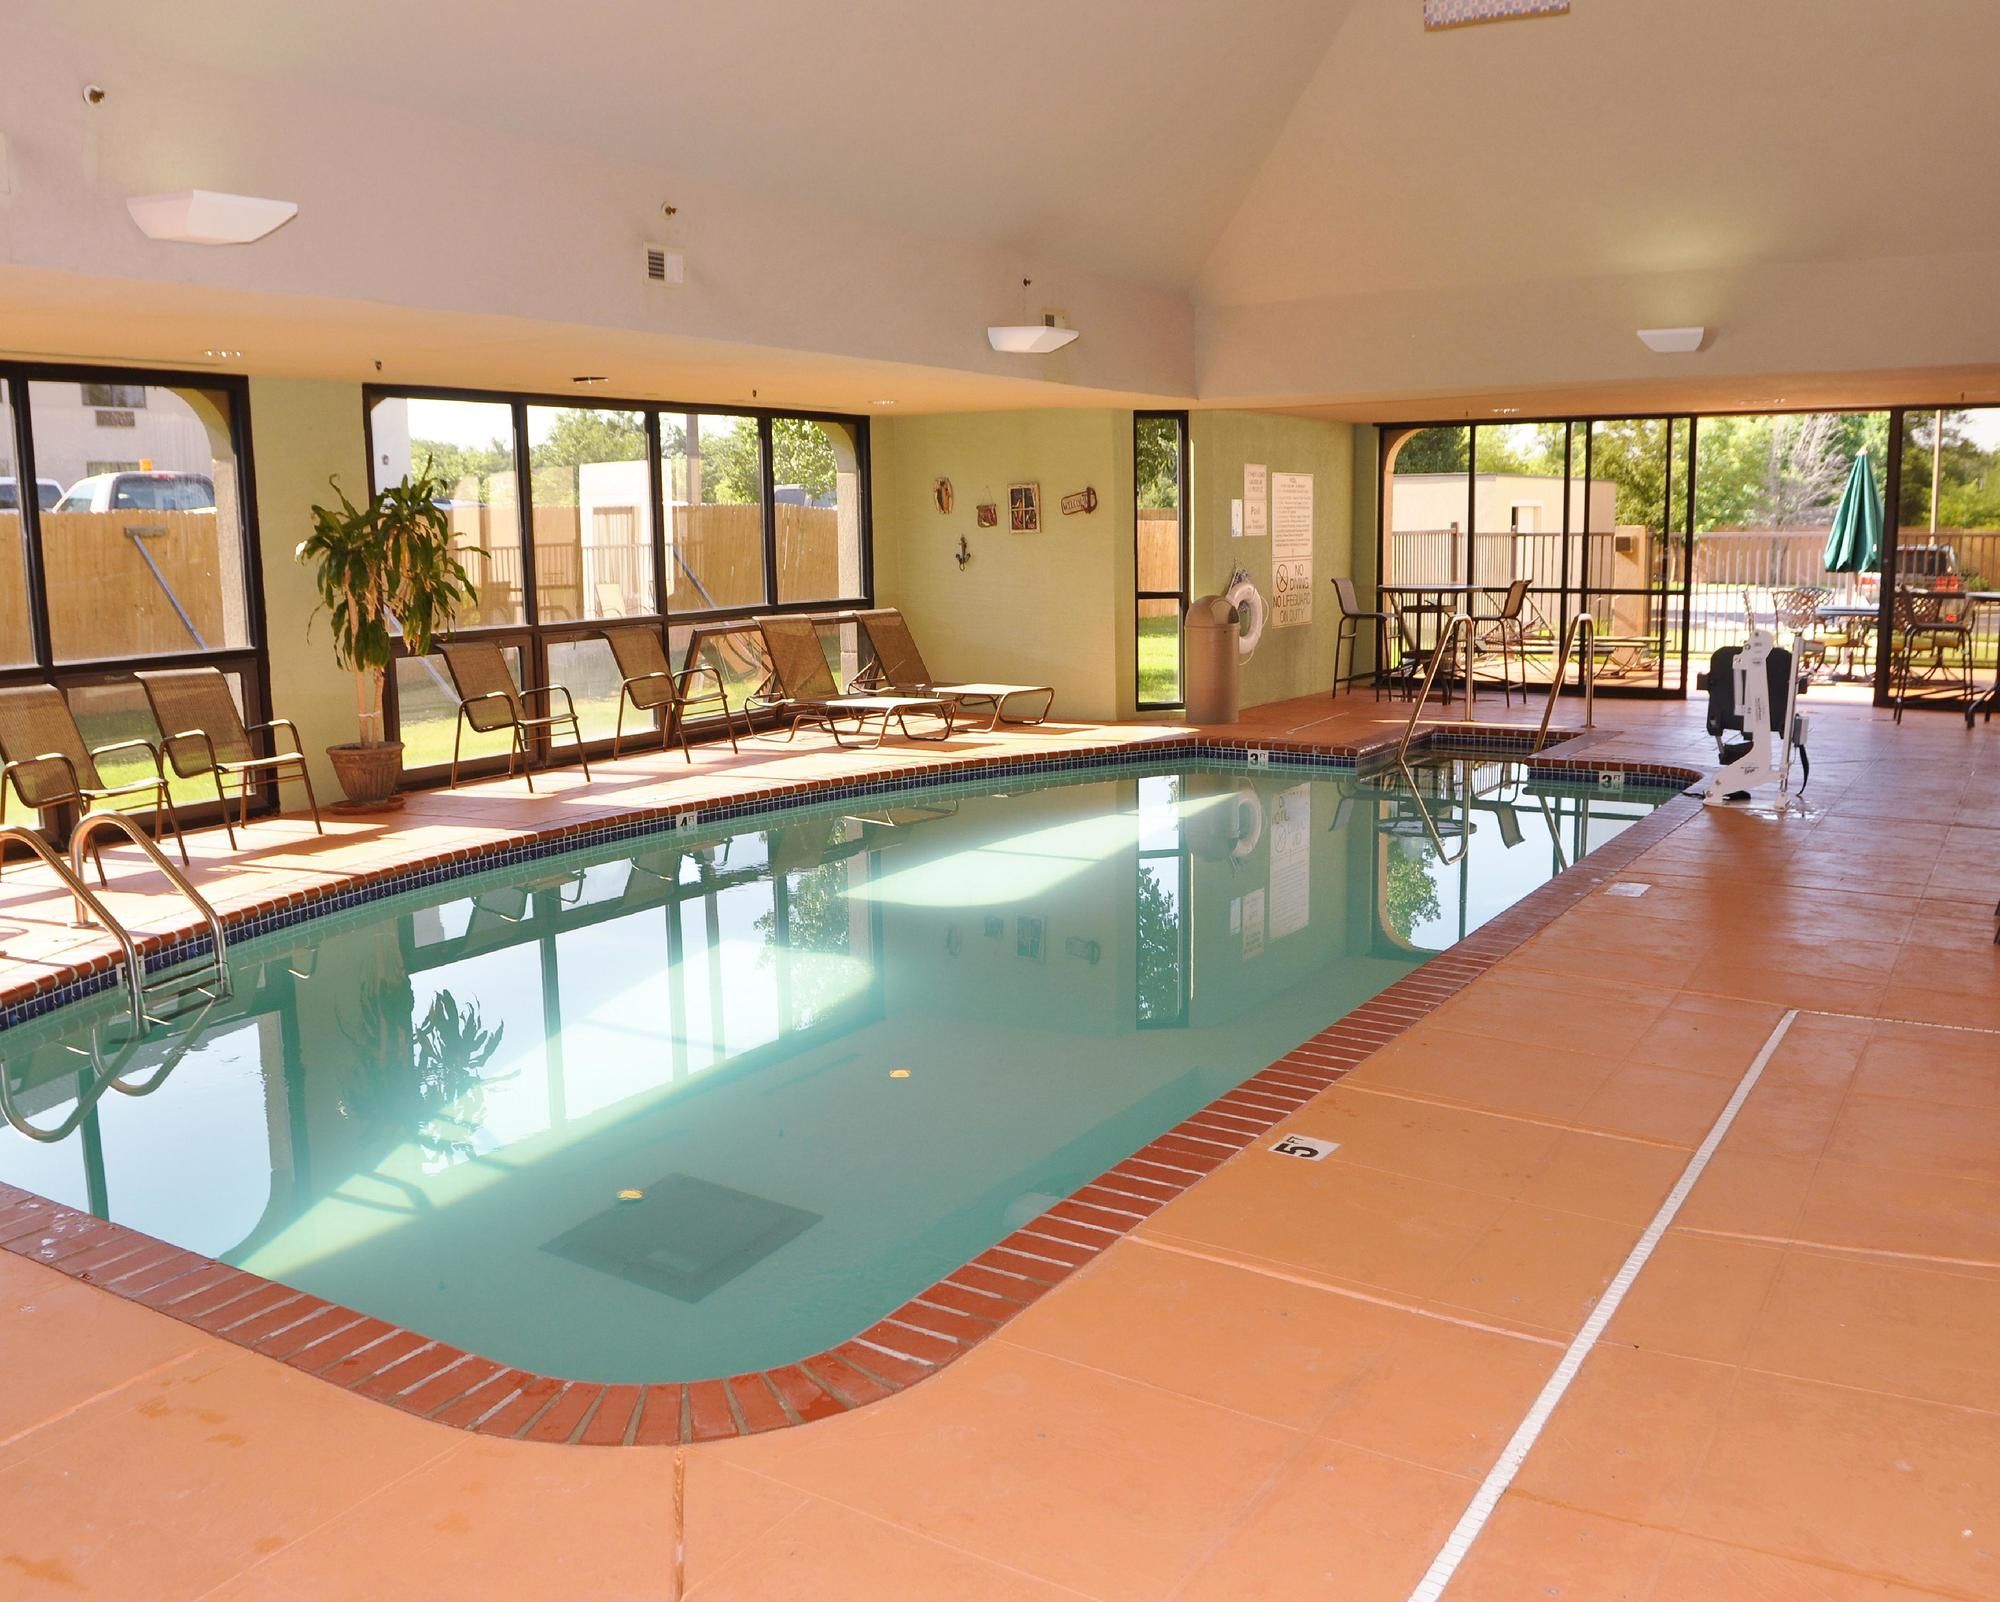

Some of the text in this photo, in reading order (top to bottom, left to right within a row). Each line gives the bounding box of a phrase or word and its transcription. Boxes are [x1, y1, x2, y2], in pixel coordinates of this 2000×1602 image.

[1294, 563, 1304, 576] NO
[1290, 576, 1309, 590] DIVING
[1272, 591, 1311, 608] NO LIFEGUARD
[1279, 607, 1304, 623] ON DUTY
[1274, 1142, 1319, 1158] 5
